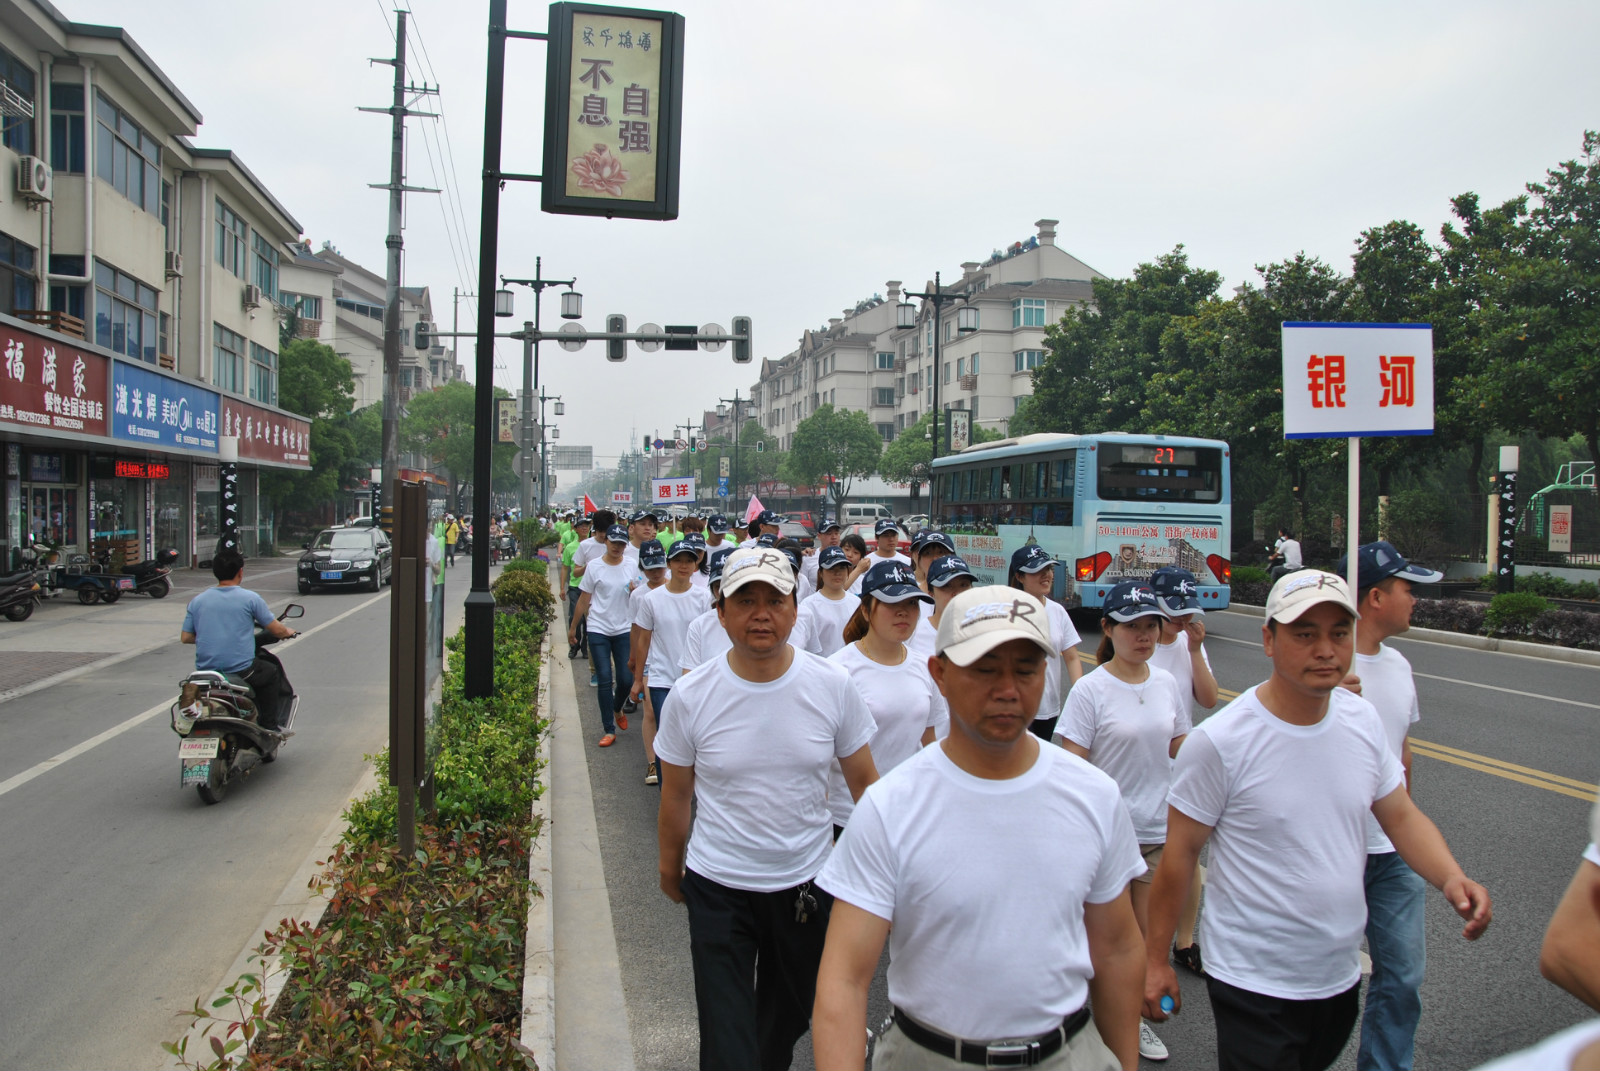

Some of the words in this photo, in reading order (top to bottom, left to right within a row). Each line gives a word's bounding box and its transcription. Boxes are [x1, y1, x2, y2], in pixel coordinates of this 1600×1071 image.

[577, 58, 614, 127] 不息
[619, 82, 652, 153] 自强
[4, 338, 87, 398] 福满家
[1307, 354, 1415, 408] 银河
[44, 391, 103, 421] 餐饮全国连锁店
[1155, 447, 1174, 464] 27
[659, 483, 689, 498] 逸洋
[1164, 526, 1219, 540] 沿街产权商铺
[961, 602, 1014, 625] SPEC
[1009, 599, 1046, 639] R
